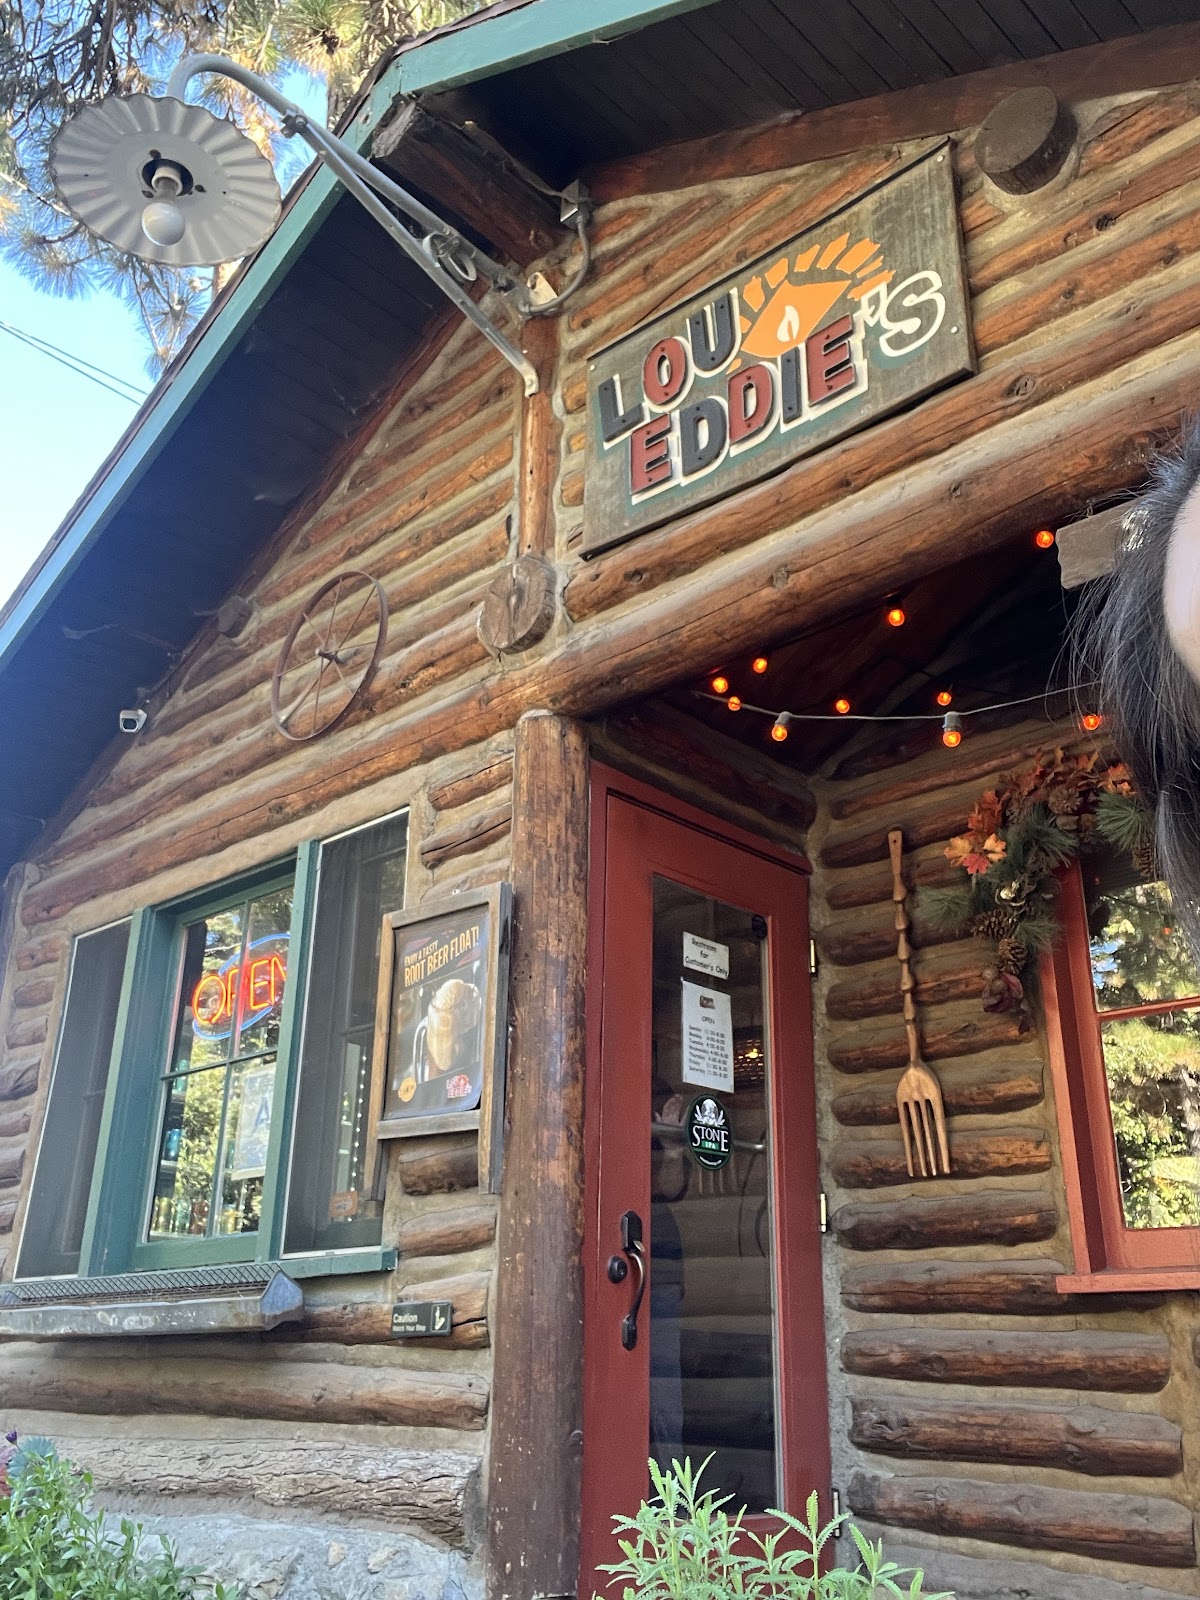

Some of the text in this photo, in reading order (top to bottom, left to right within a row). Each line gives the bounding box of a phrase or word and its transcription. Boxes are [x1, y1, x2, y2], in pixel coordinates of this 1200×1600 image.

[598, 287, 740, 450] LOU
[630, 270, 945, 505] EDDIE'S
[418, 950, 422, 960] A
[422, 940, 439, 958] TASTY
[692, 937, 717, 952] Restroom
[700, 950, 709, 958] for
[405, 926, 479, 987] ROOT BEER FLOAT!
[685, 956, 728, 977] Customer's Only
[702, 1016, 715, 1025] OPEN
[692, 1125, 729, 1152] STONE
[705, 1141, 717, 1149] IPA
[393, 1313, 418, 1324] Caution
